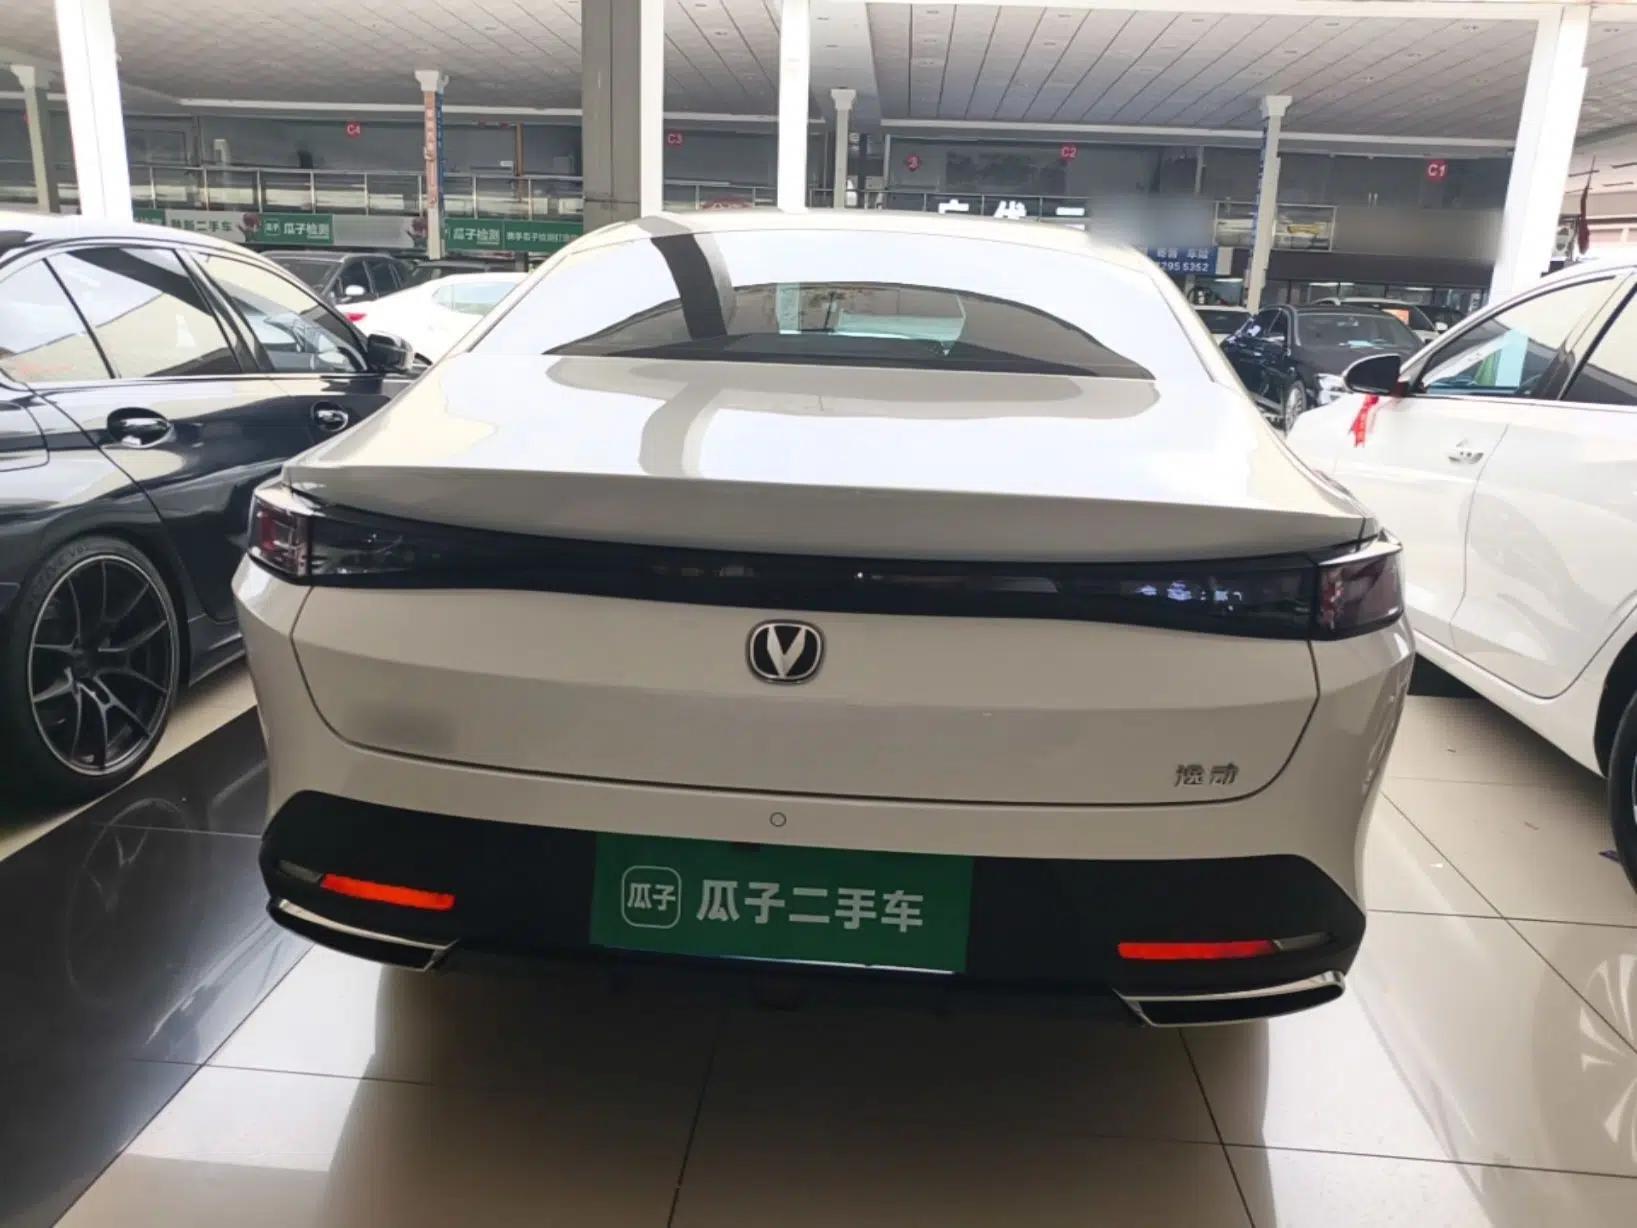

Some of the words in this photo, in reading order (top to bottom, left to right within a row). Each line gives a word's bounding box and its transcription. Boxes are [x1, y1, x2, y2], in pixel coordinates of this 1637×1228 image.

[1428, 164, 1446, 177] C1
[1174, 762, 1239, 787] 逸动
[627, 882, 677, 912] 瓜子
[696, 879, 924, 933] 瓜子二手车
